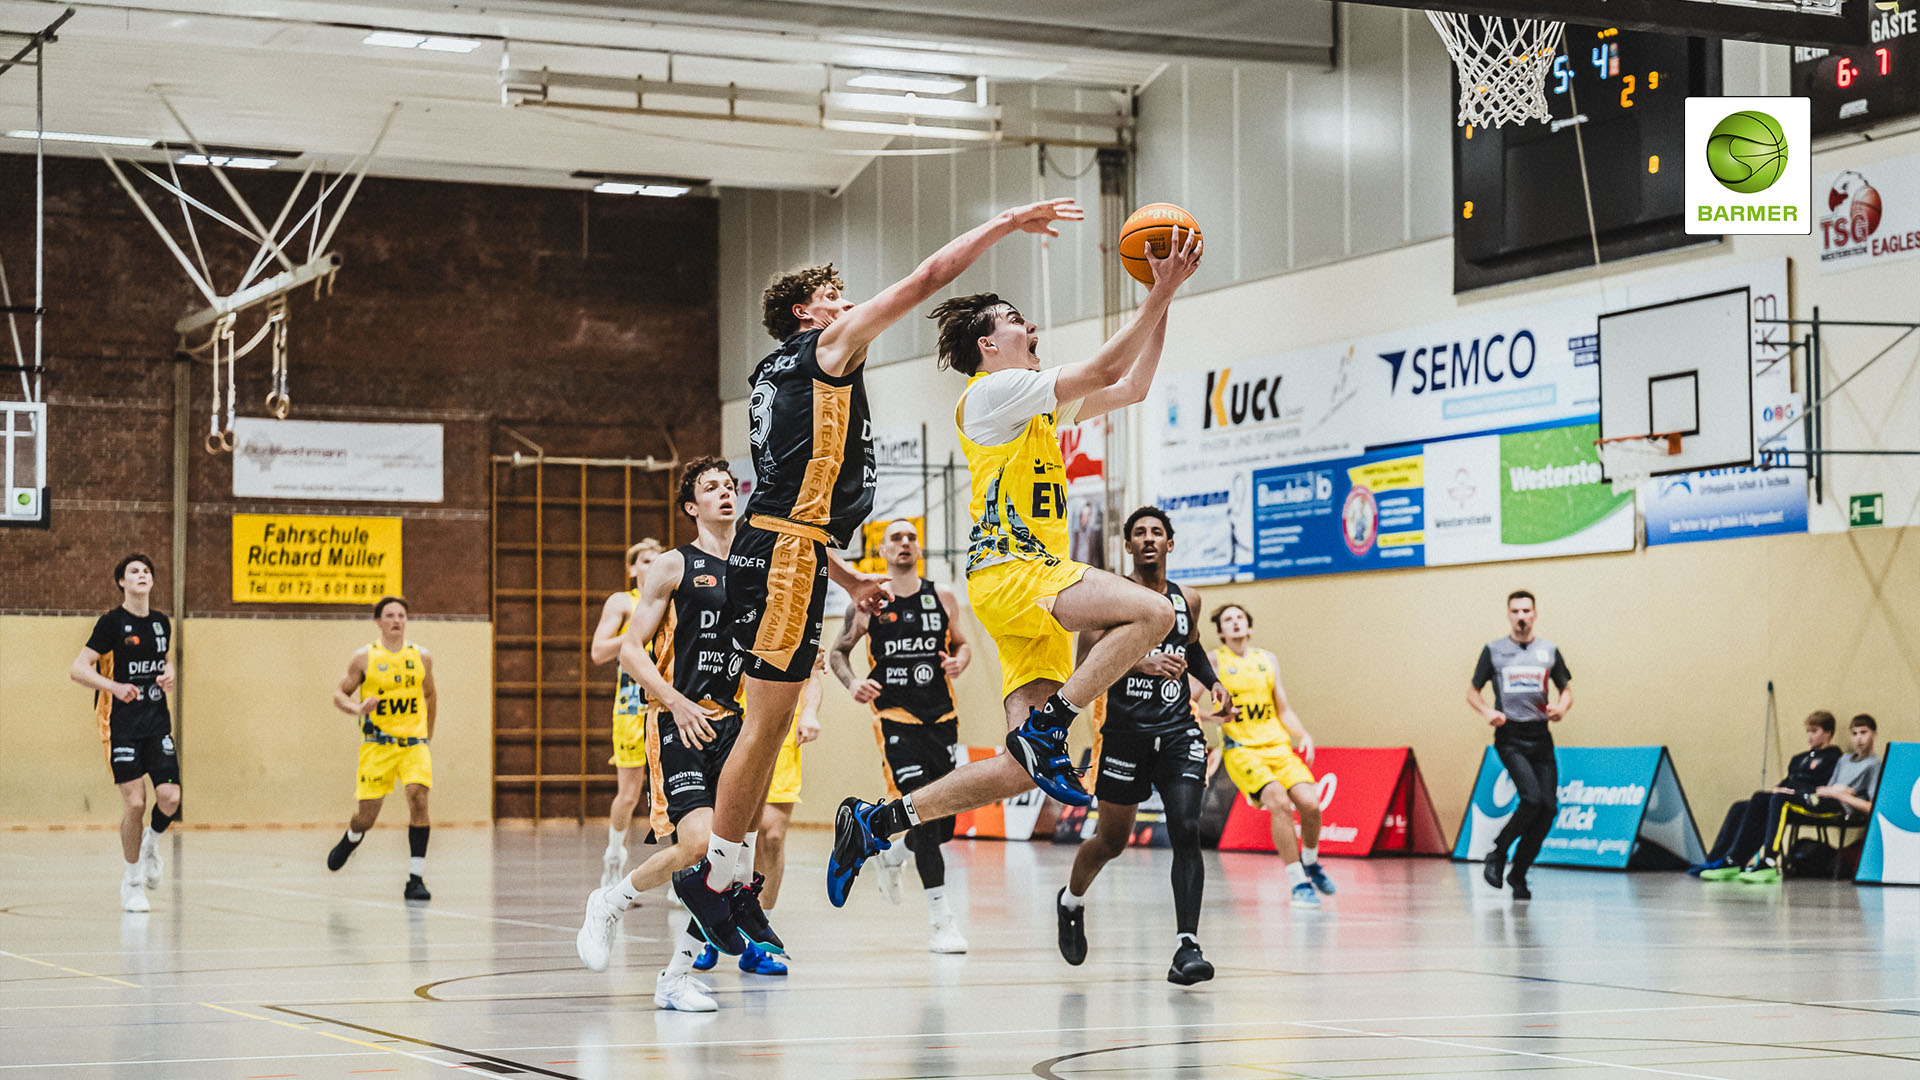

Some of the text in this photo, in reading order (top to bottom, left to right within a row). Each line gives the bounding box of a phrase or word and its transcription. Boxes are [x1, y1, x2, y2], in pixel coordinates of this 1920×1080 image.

[1871, 9, 1917, 43] GÄSTE
[1820, 214, 1868, 250] TSG
[1411, 329, 1537, 395] SEMCO
[749, 380, 777, 449] 3
[264, 523, 369, 545] Fahrschule
[248, 546, 386, 567] Richard Müller
[921, 612, 942, 631] 15
[884, 636, 937, 656] DIEAG
[376, 698, 418, 716] EWE
